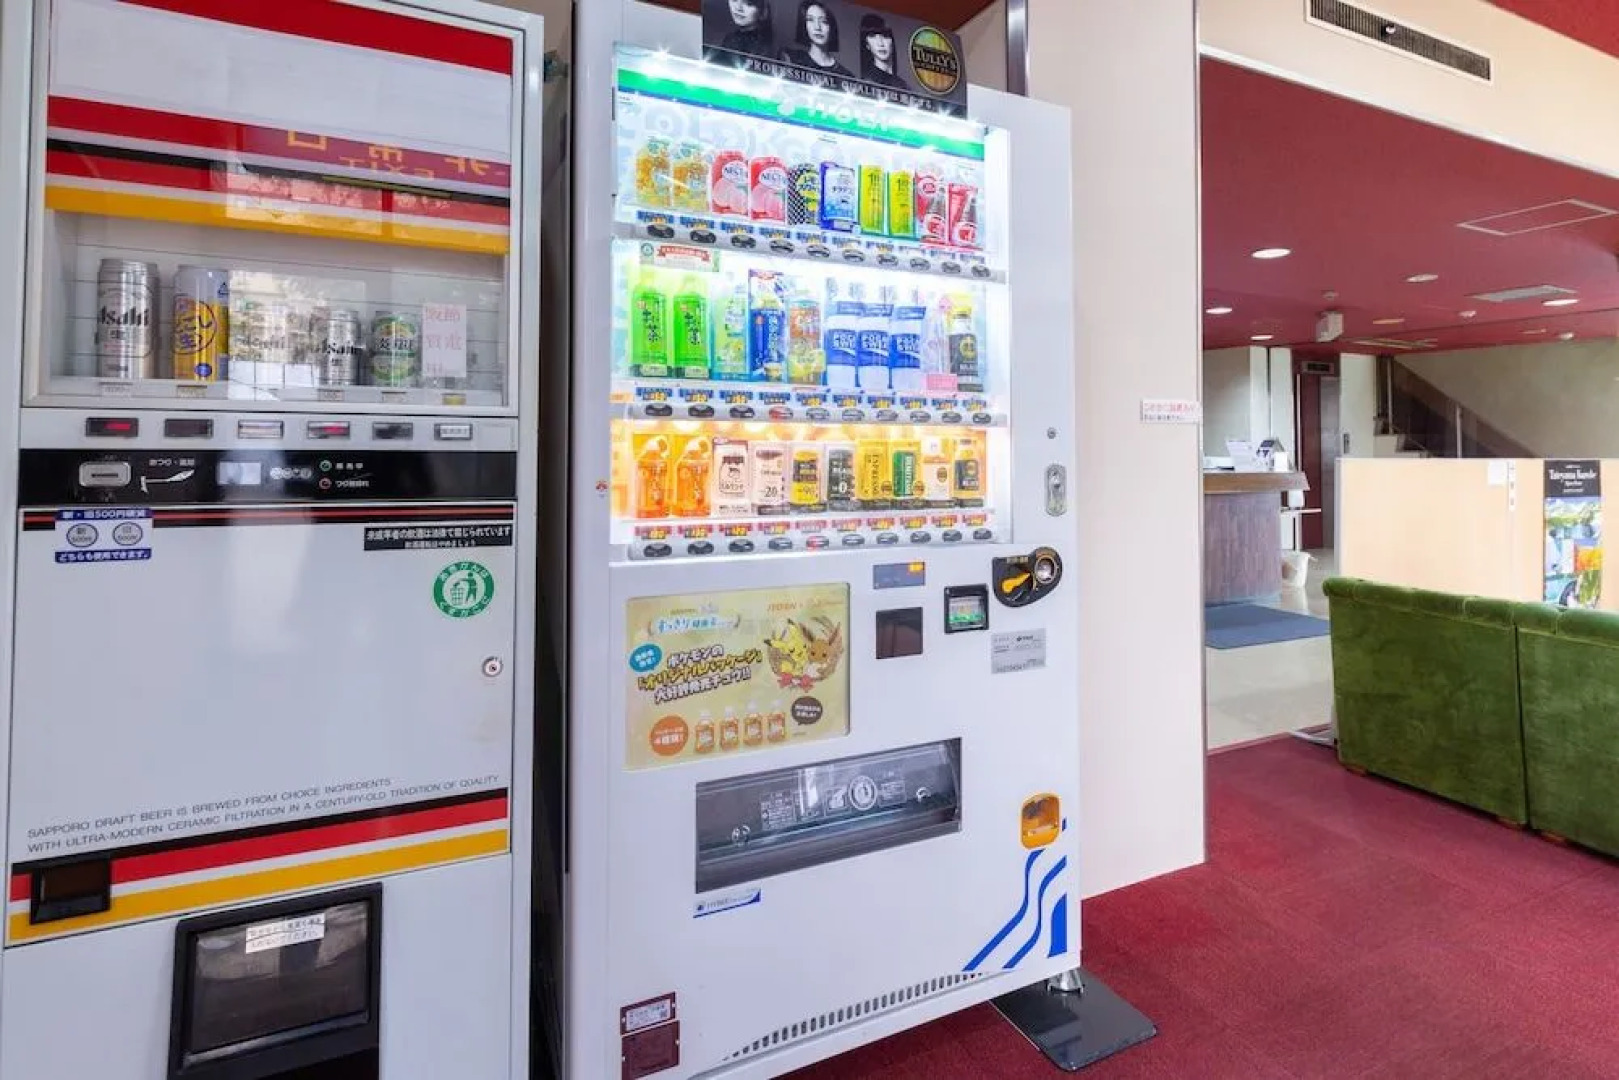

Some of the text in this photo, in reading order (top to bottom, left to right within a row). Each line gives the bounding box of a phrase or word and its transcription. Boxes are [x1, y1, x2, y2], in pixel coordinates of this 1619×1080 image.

[26, 774, 500, 854] WITH ULTRA-MODERN CERAMIC FILTRATION IN A CENTURY-OLD TRADITION OF QUALITY
[27, 778, 391, 839] SAPPORO DRAFT BEER IS BREWED FROM CHOICE INGREDIENTS
